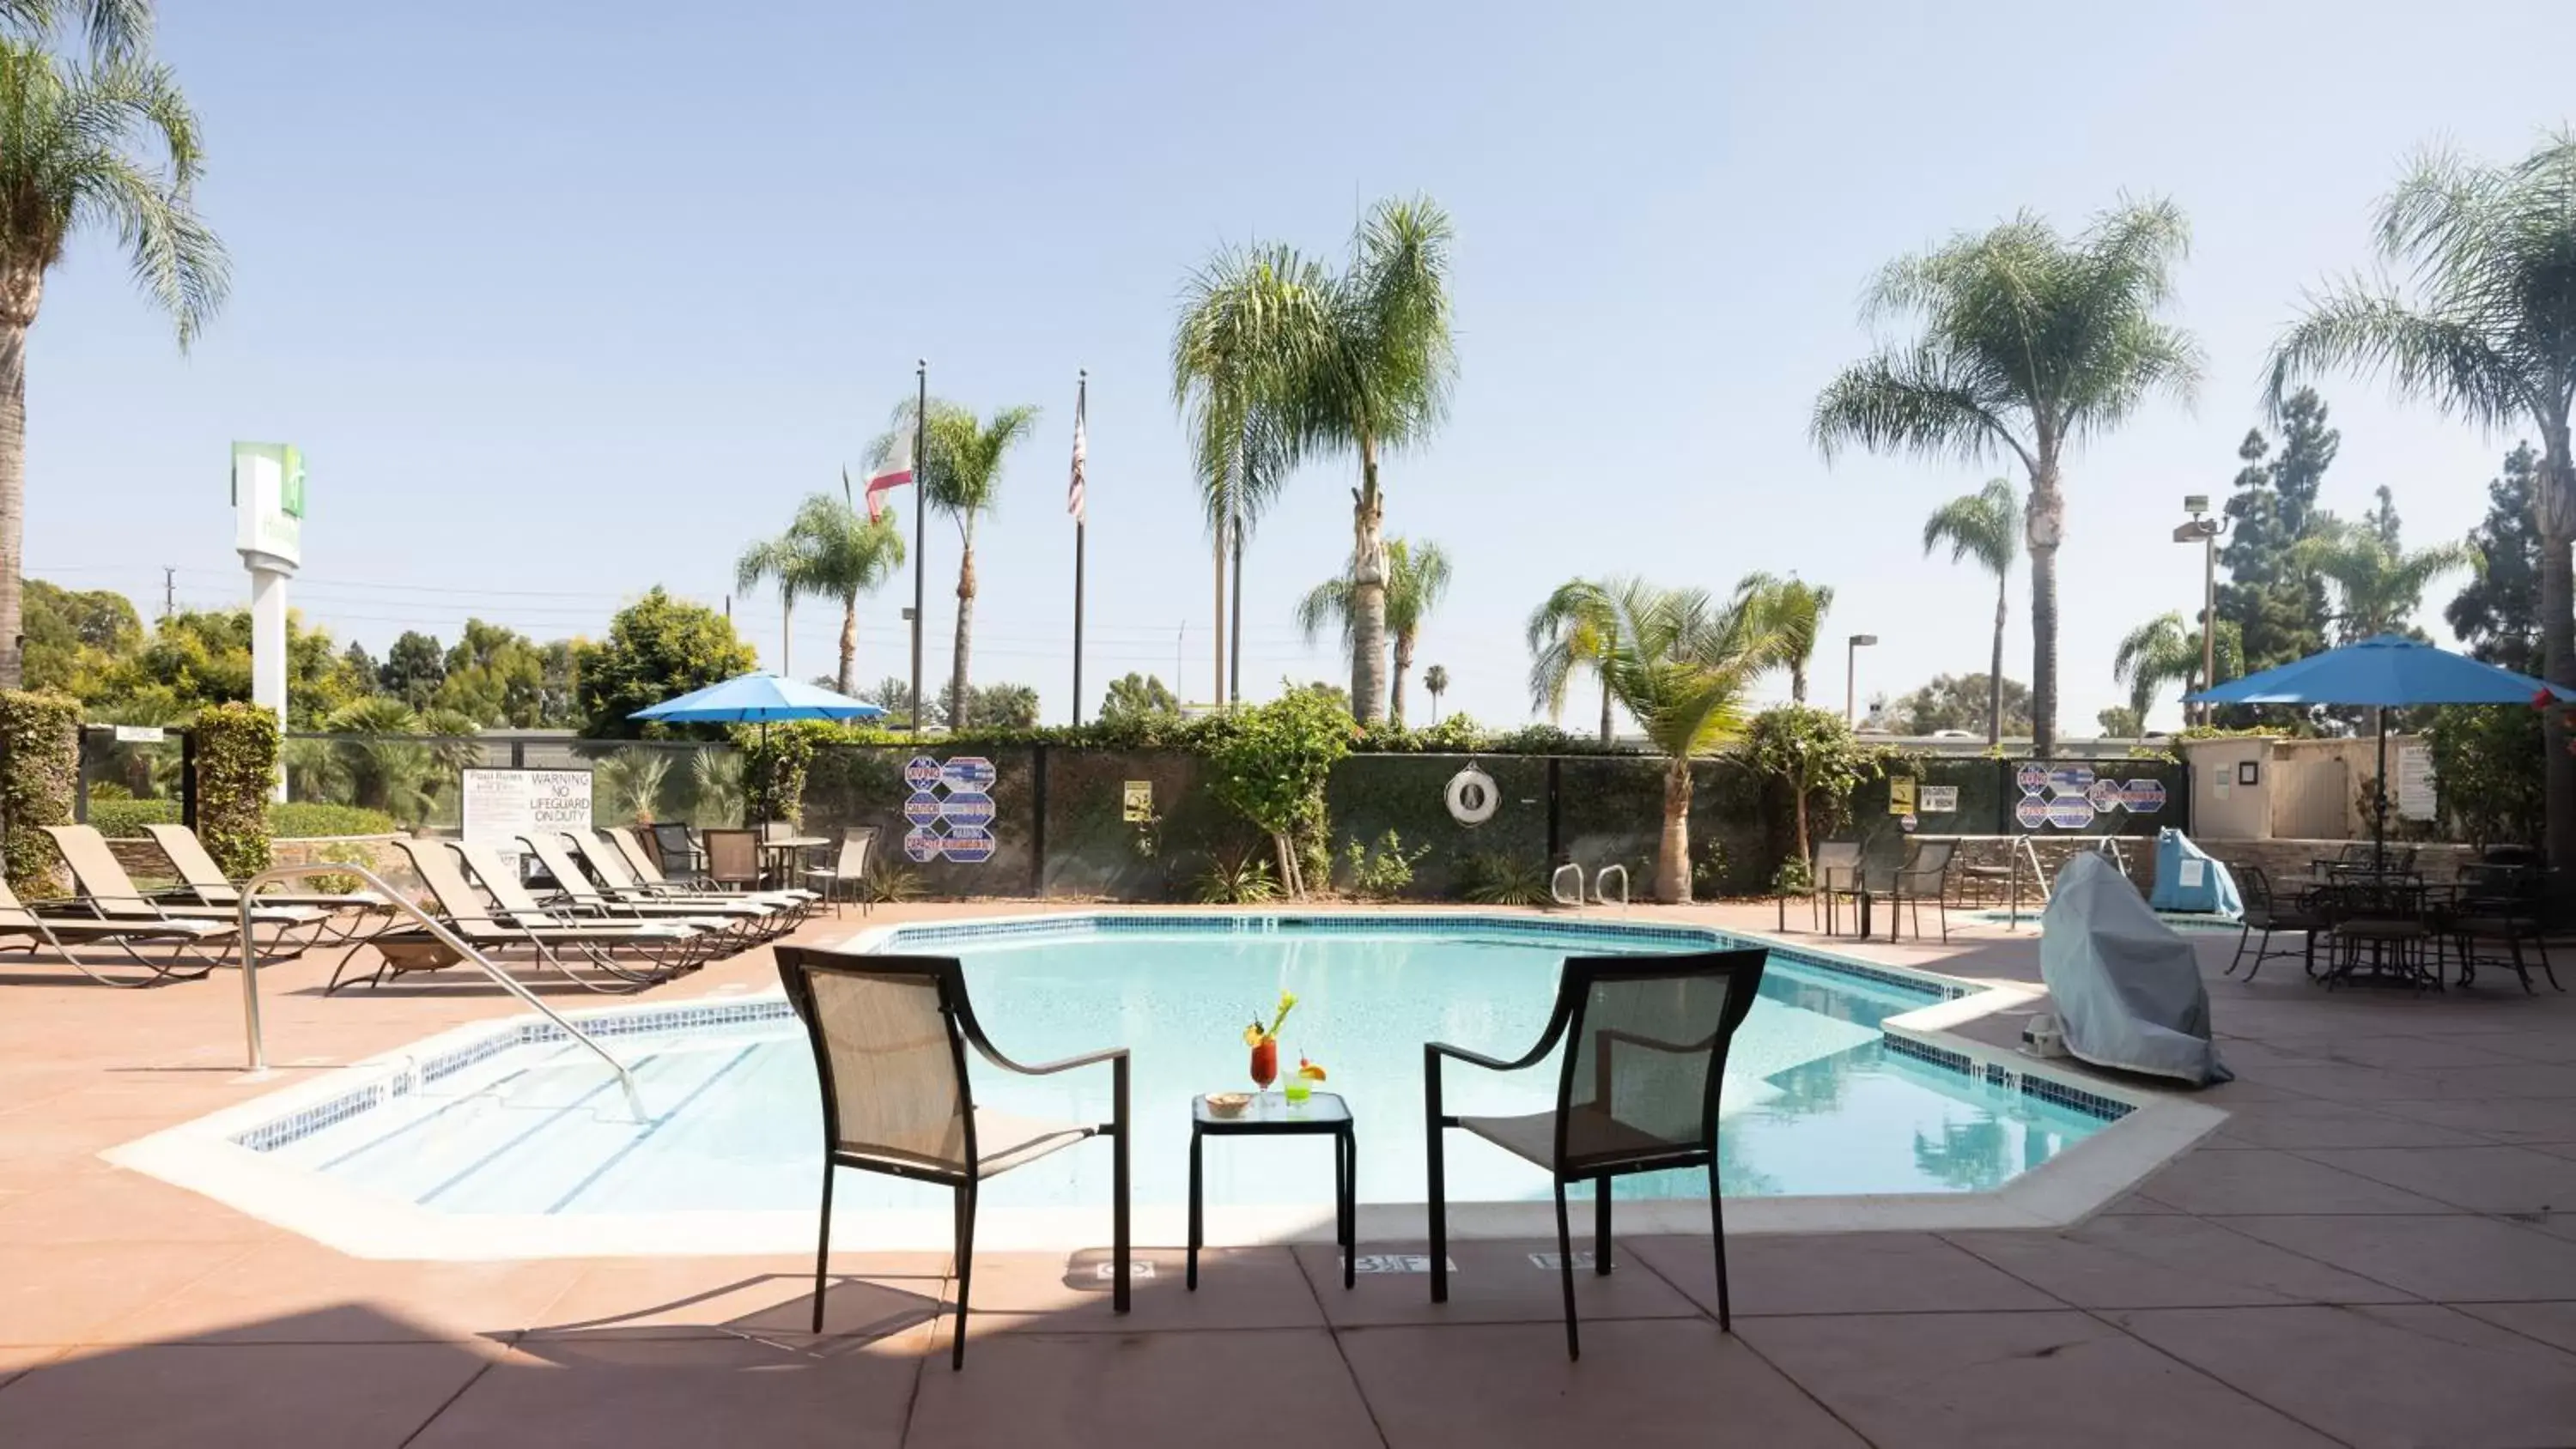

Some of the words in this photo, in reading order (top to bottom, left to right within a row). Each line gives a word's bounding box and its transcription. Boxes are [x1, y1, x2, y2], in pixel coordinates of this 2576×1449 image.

[532, 773, 589, 785] WARNING
[552, 785, 569, 797] NO
[530, 797, 590, 809] LIFEGUARD
[535, 810, 553, 822] ON
[555, 810, 586, 822] DUTY
